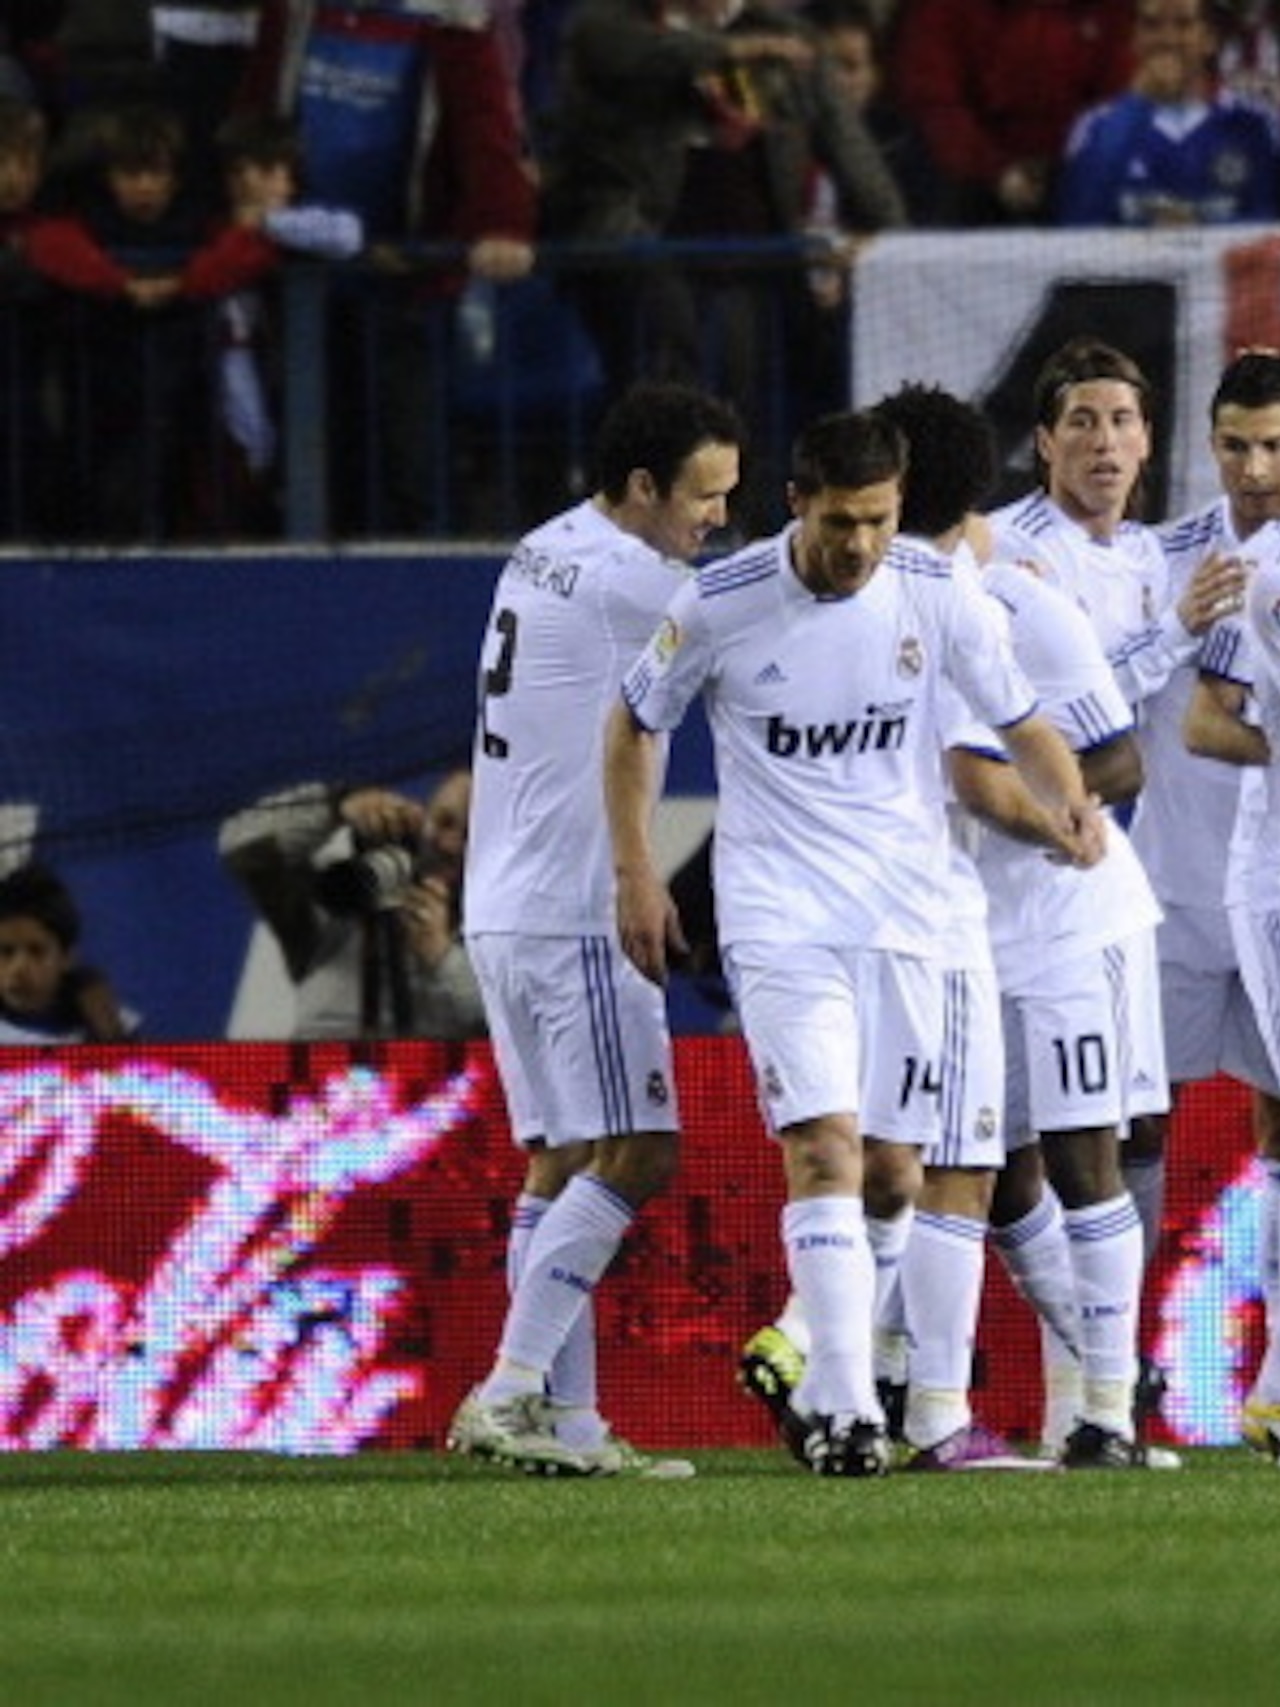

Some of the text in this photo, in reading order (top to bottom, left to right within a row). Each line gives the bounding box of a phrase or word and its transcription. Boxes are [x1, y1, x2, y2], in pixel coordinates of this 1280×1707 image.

[768, 703, 906, 758] bwin
[899, 1056, 942, 1112] 14
[1053, 1035, 1107, 1096] 10
